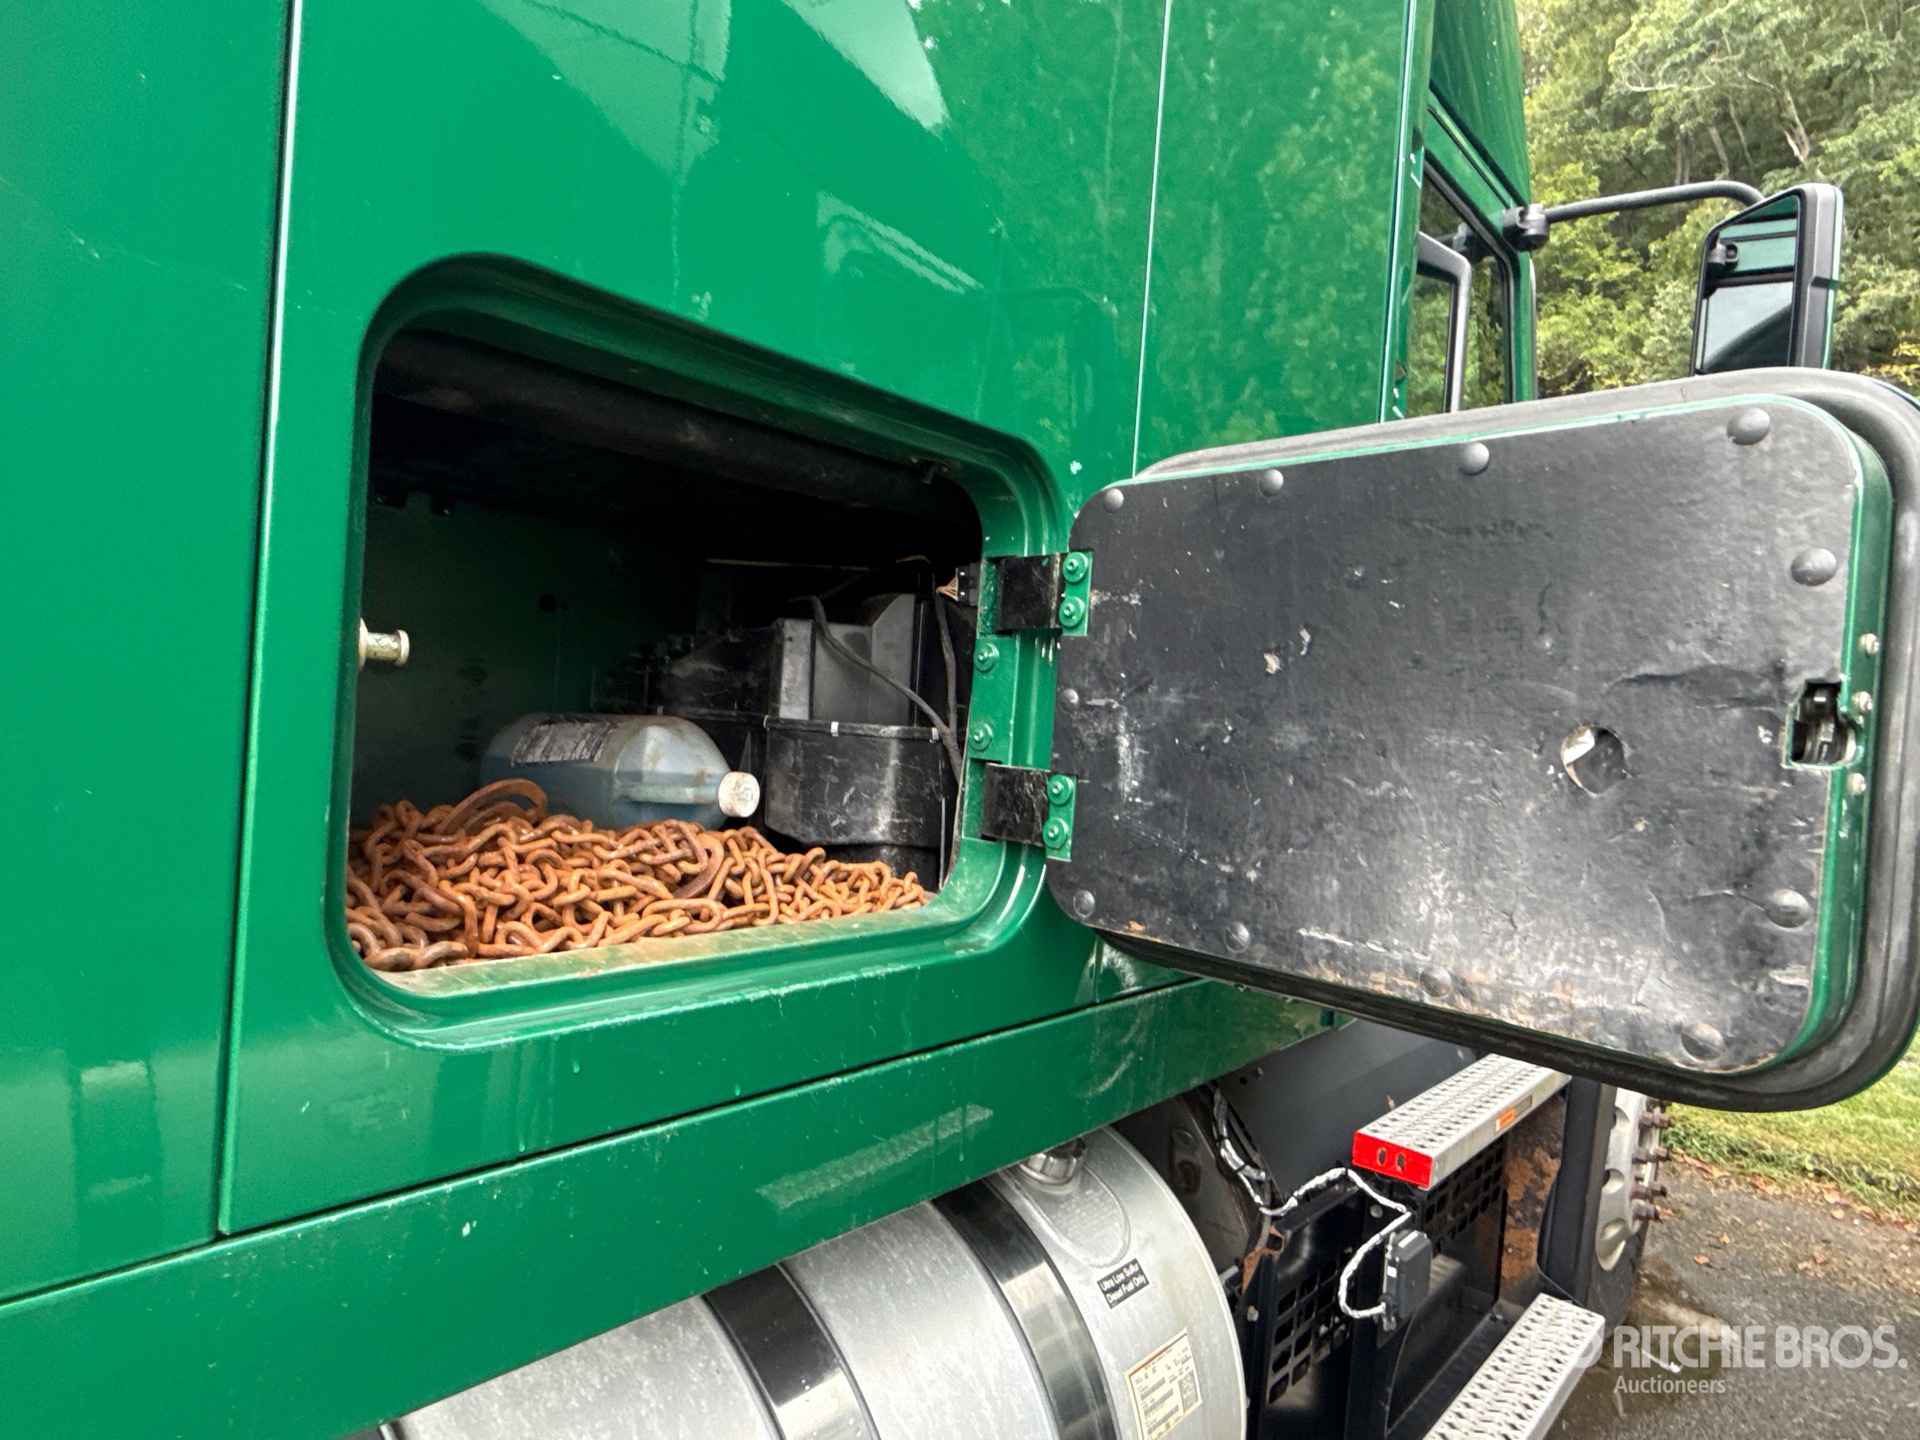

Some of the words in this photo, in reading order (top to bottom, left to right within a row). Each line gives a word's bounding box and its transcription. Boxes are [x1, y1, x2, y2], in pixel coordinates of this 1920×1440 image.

[1100, 1279, 1115, 1291] Ultra
[1112, 1272, 1125, 1284] Low
[1123, 1263, 1139, 1277] Sulfur
[1106, 1287, 1124, 1303] Diesel
[1121, 1280, 1135, 1294] Fuel
[1133, 1274, 1146, 1286] Only
